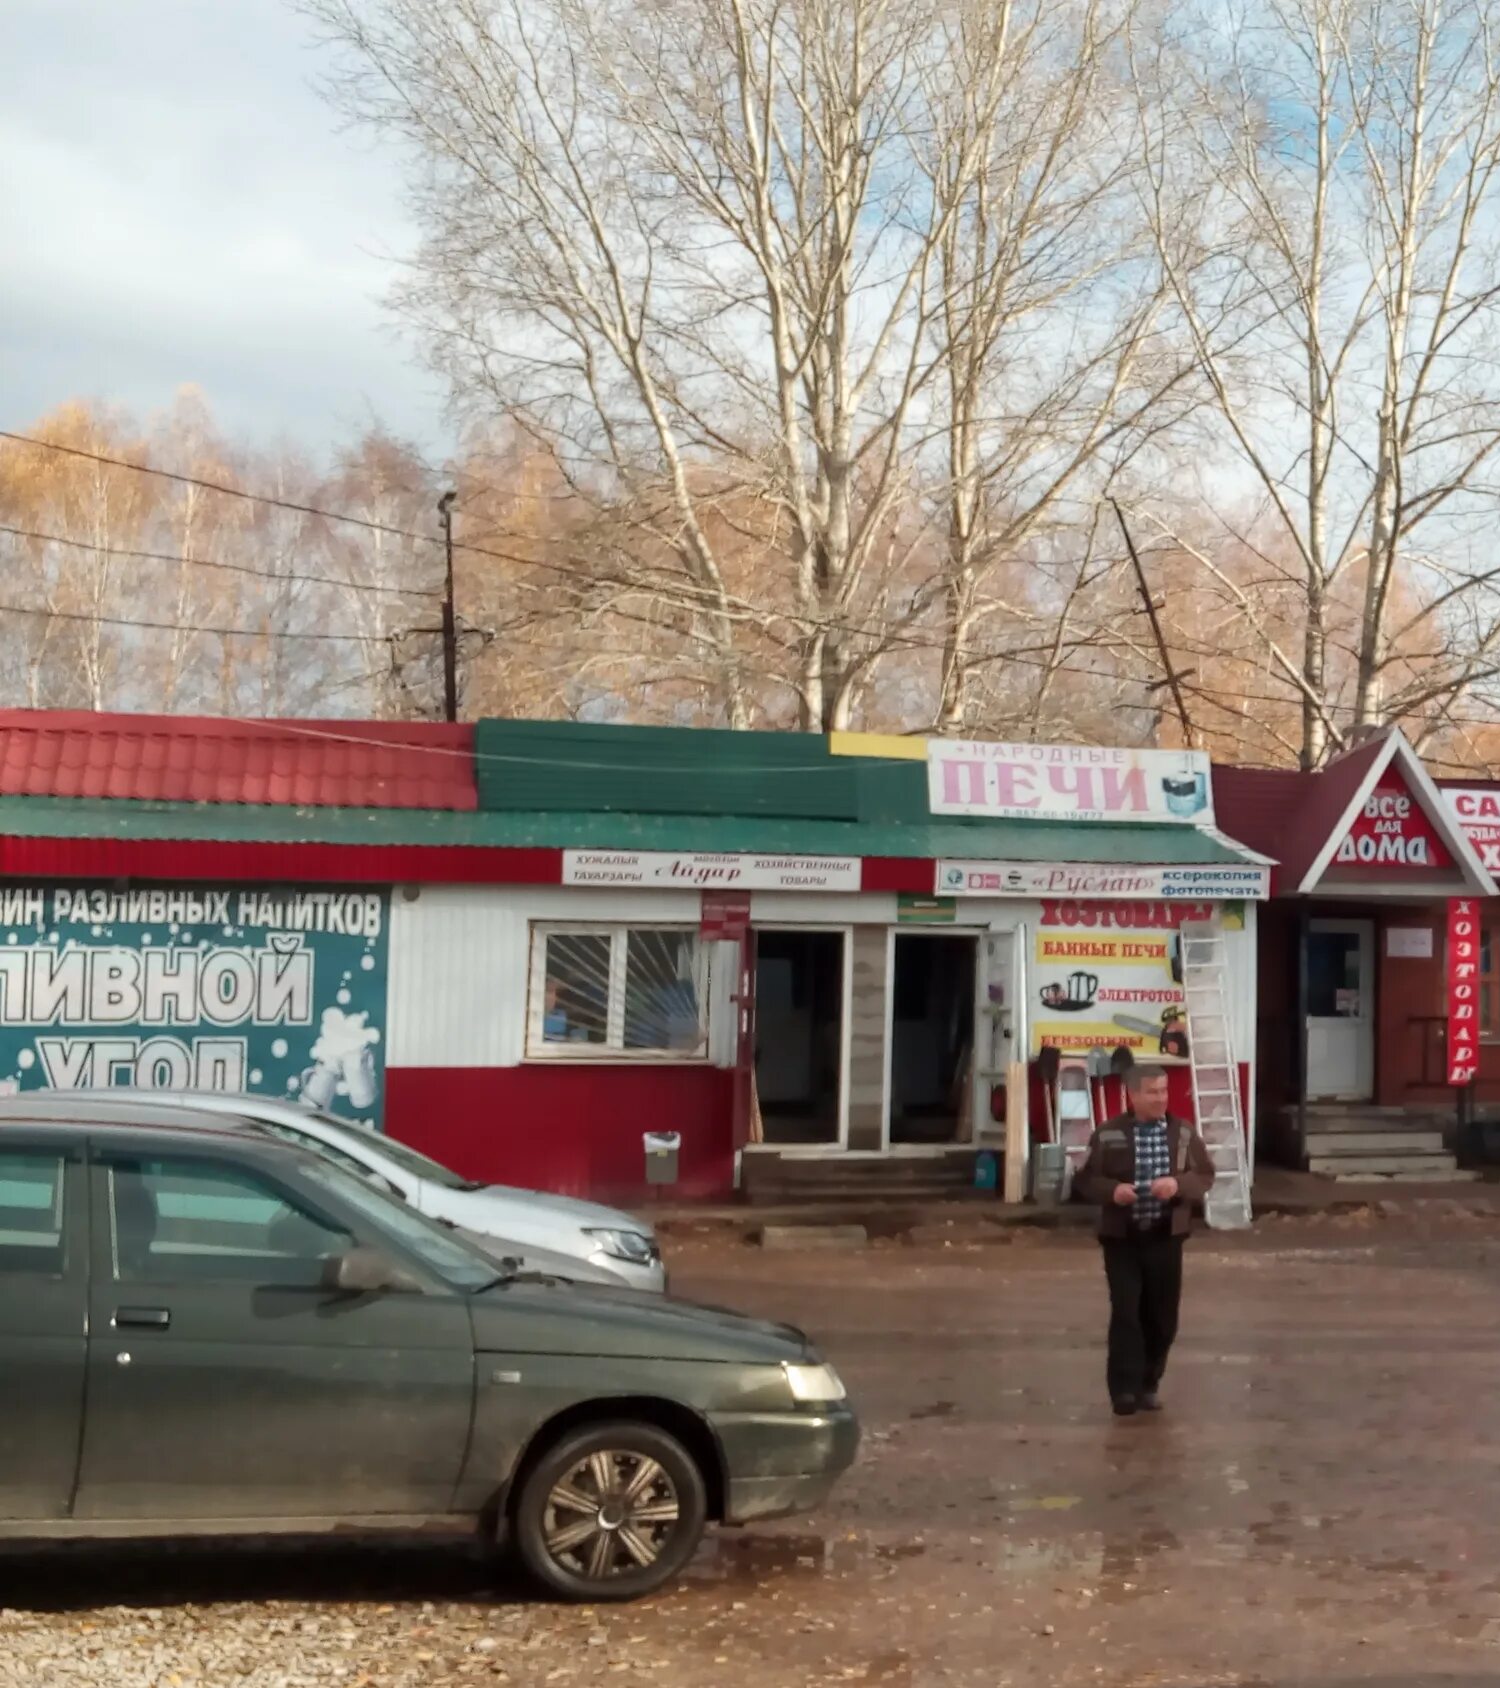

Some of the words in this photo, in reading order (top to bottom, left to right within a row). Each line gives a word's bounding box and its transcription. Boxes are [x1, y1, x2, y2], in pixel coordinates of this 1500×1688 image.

[973, 744, 1125, 764] НАРОДНЫЕ
[941, 759, 1150, 812] ПЕЧИ
[754, 858, 852, 873] ХОЗЯЙСТВЕННЫЕ
[780, 875, 827, 885] ТОВАРЫ
[1162, 871, 1262, 882] ксерокопия
[1161, 885, 1261, 897] фотопечать
[0, 887, 44, 926] ИН
[53, 889, 231, 926] РАЗЛИВНЫХ
[238, 893, 381, 938] НАПИТКОВ
[1043, 941, 1117, 957] БАННЫЕ
[1121, 943, 1166, 958] ПЕЧИ
